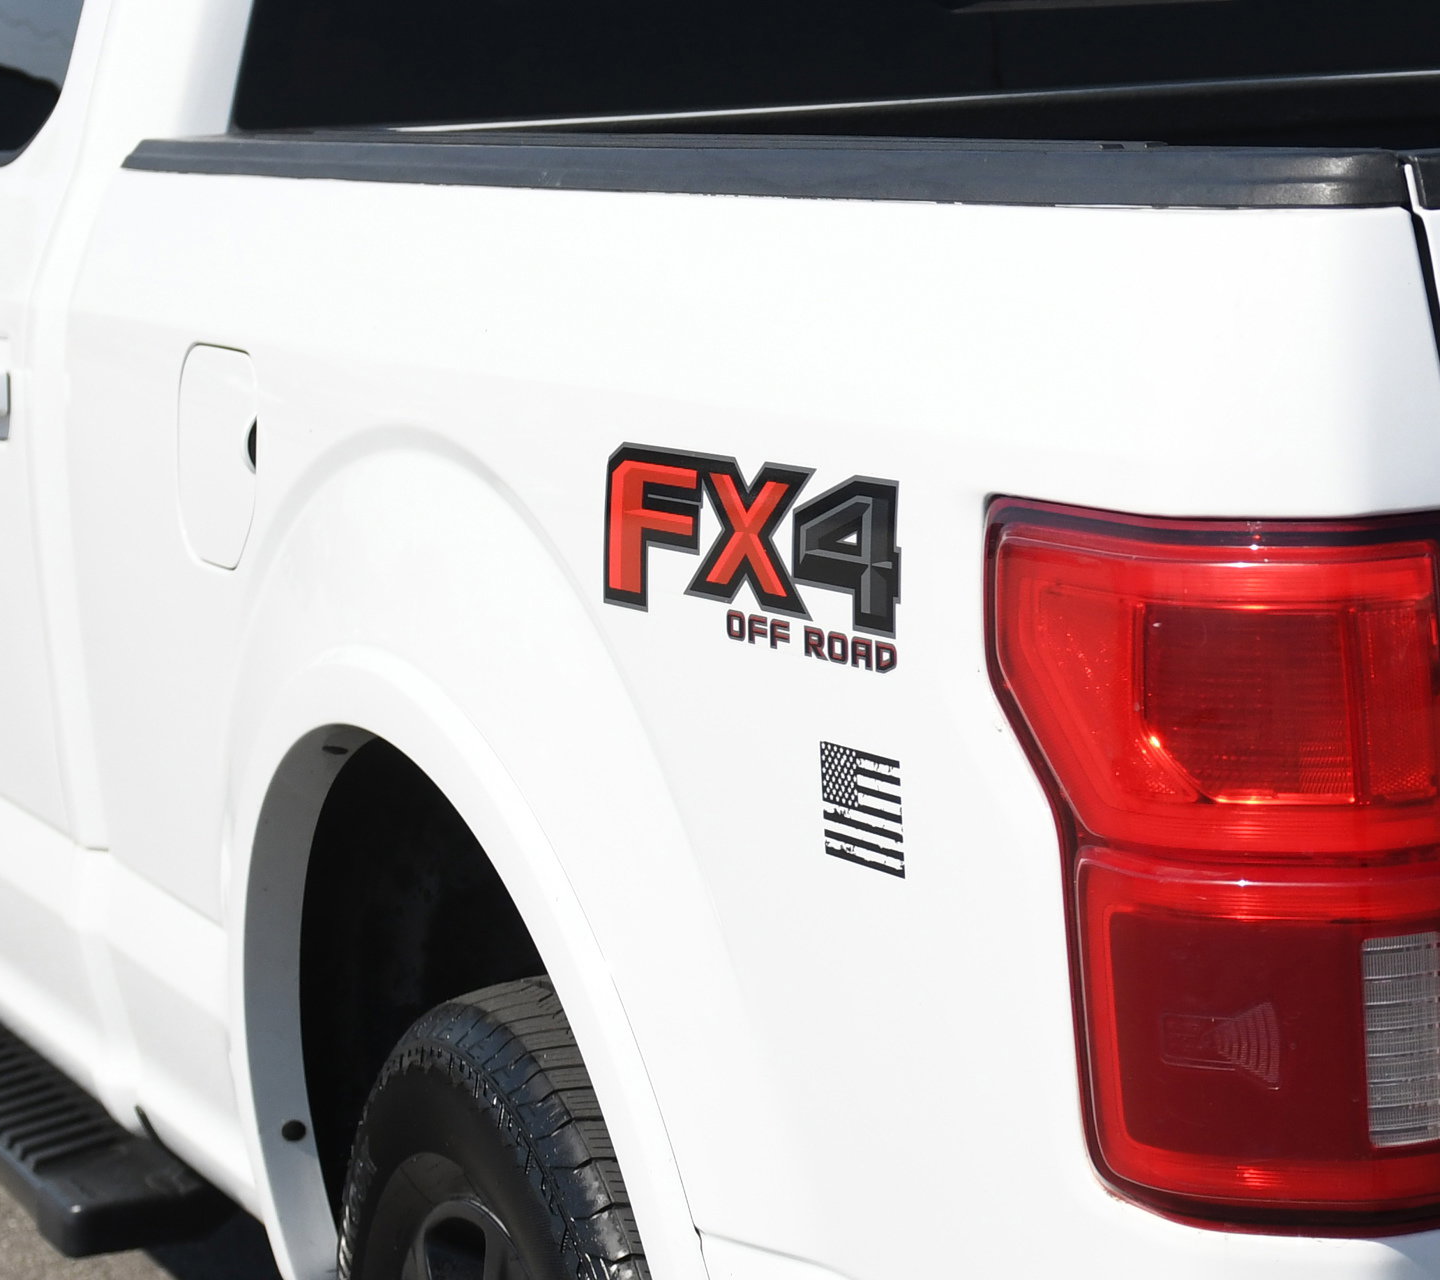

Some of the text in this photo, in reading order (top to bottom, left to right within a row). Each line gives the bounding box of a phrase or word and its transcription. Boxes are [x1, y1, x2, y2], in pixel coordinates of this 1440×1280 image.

[603, 441, 901, 639] FX4
[726, 609, 898, 674] OFF ROAD
